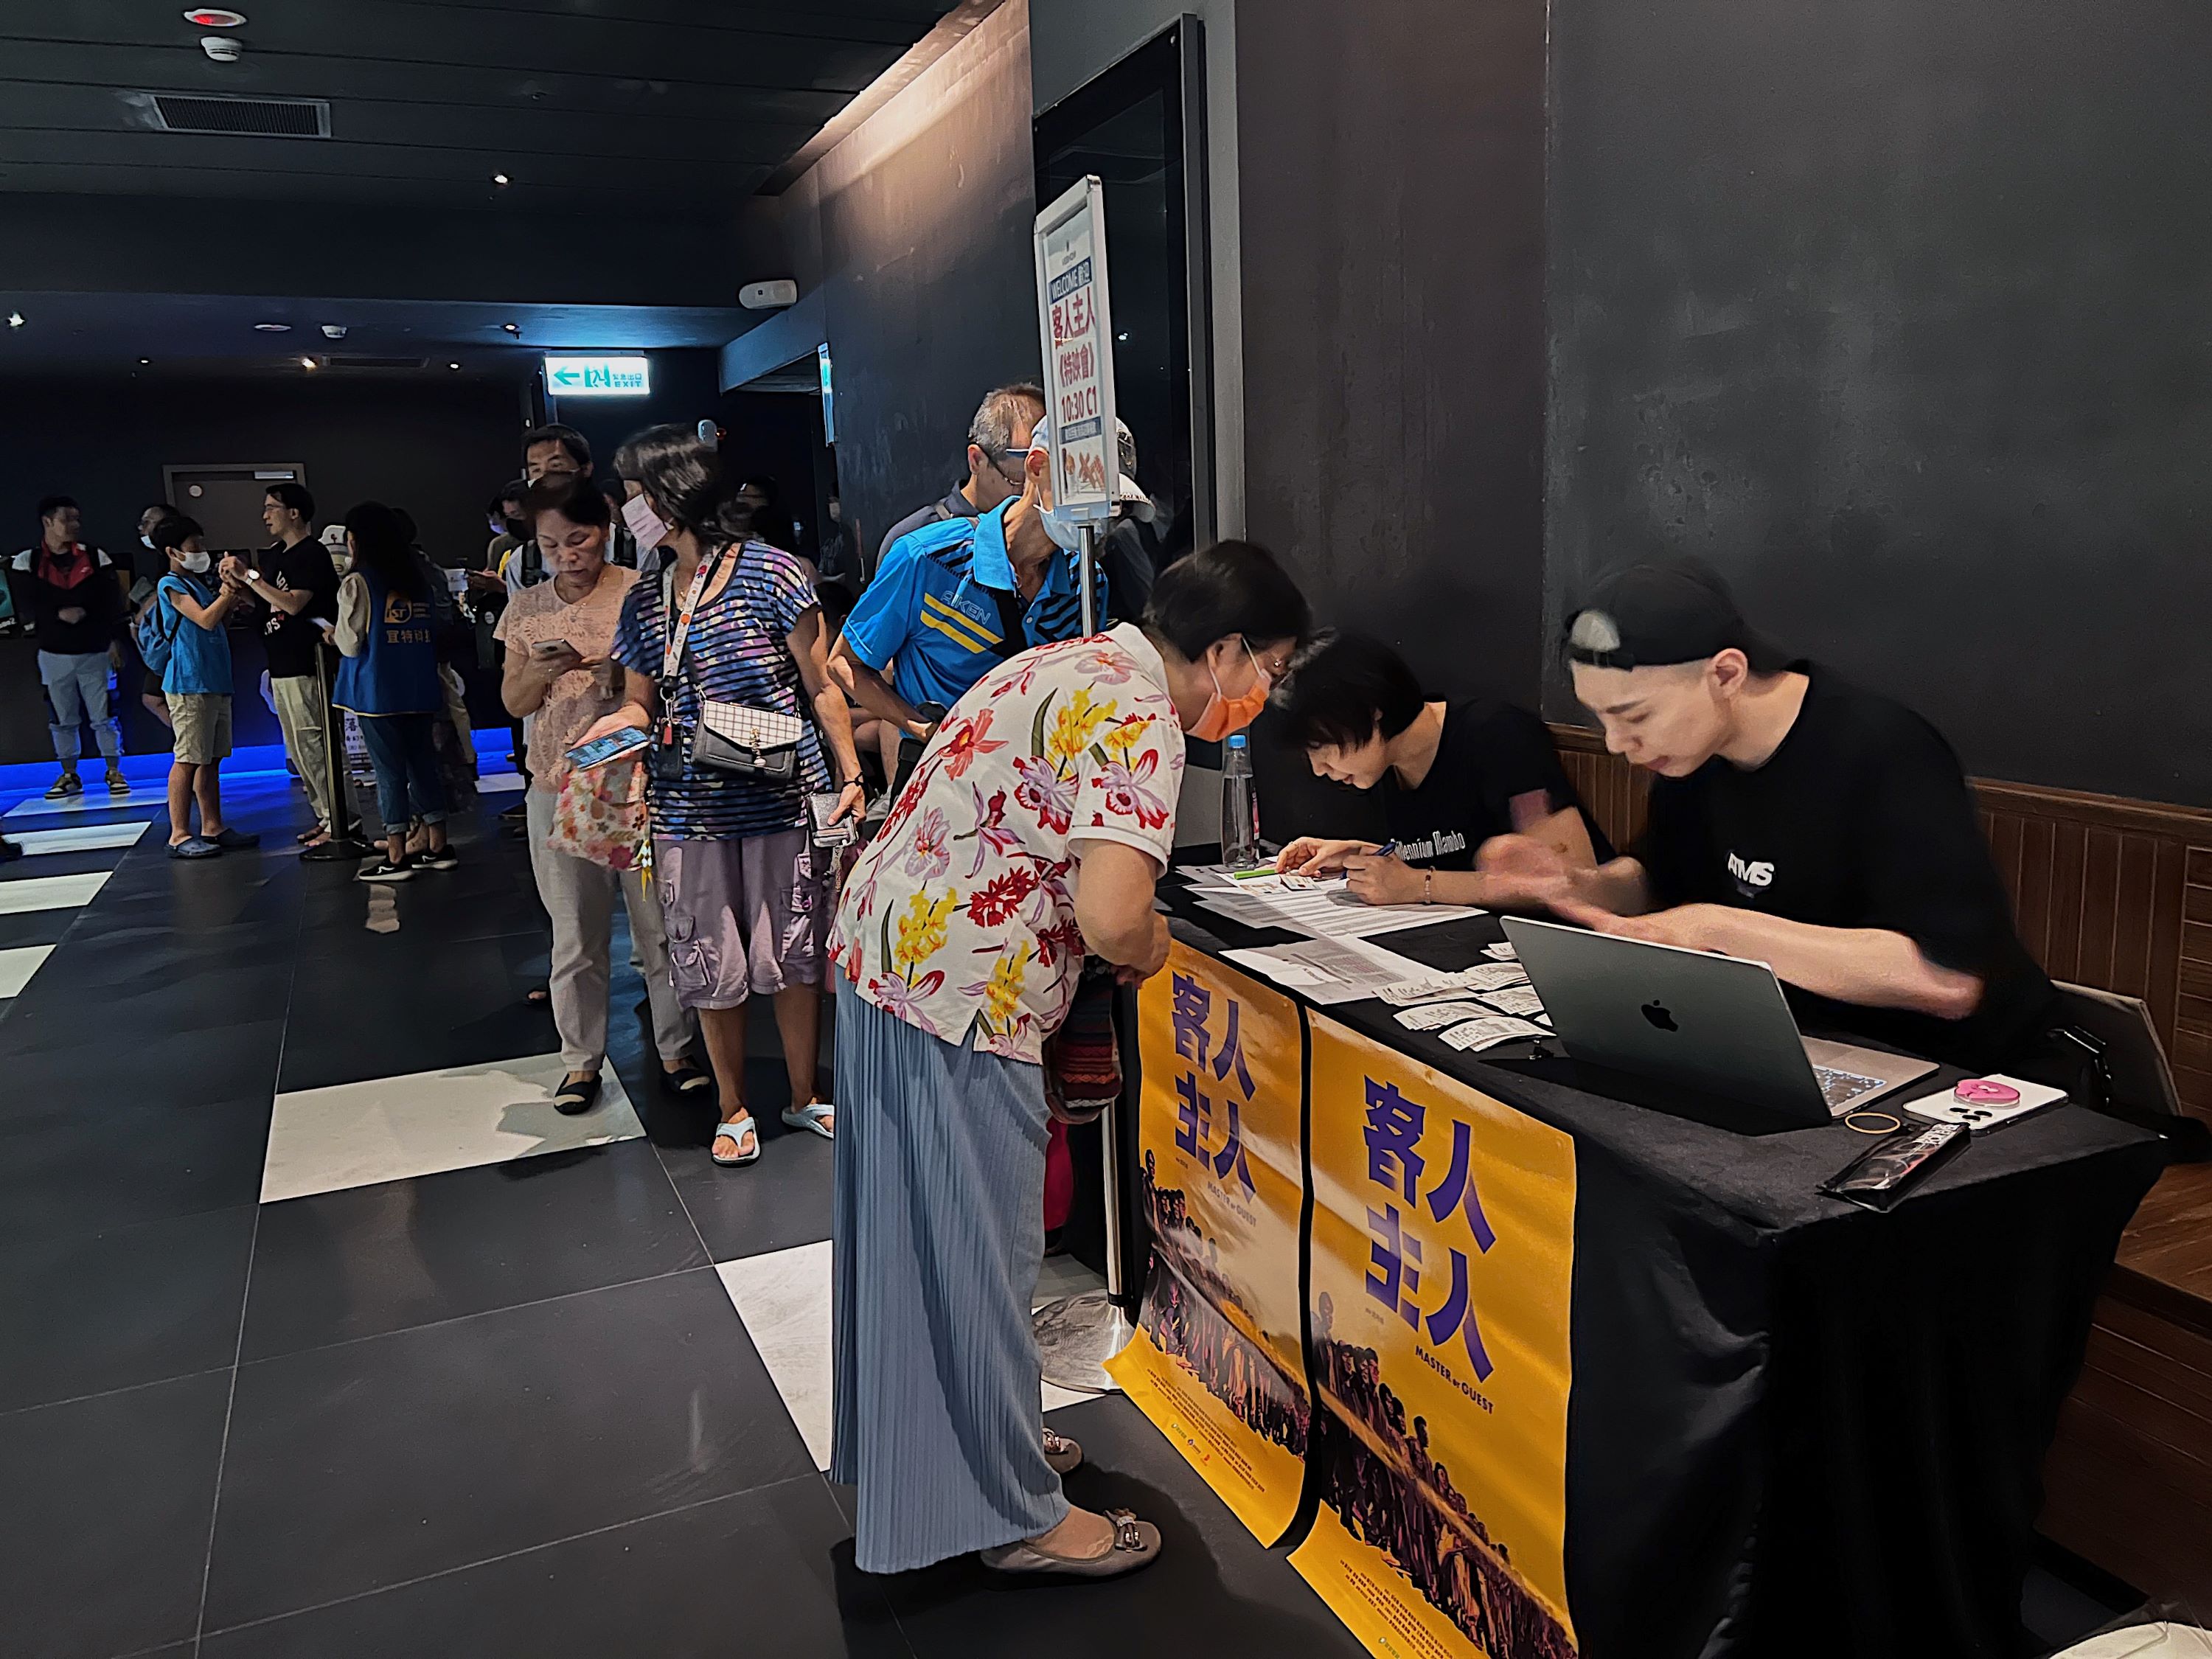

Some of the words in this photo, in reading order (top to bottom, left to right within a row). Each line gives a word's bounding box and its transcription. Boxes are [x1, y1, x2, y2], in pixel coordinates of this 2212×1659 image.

[1051, 268, 1077, 300] WELCOME
[1052, 285, 1096, 349] 客人主人
[1061, 390, 1085, 423] 10:30
[1086, 385, 1097, 416] C1
[1390, 838, 1434, 861] illennium
[1432, 830, 1466, 855] Mambo
[1172, 970, 1256, 1102] 客人
[1175, 1071, 1256, 1204] 主人
[1363, 1074, 1496, 1254] 客人
[1207, 1180, 1230, 1206] MASTER
[1236, 1204, 1257, 1228] GUEST
[1366, 1202, 1494, 1383] 主人
[1415, 1345, 1452, 1383] MASTER
[1461, 1382, 1494, 1414] GUEST
